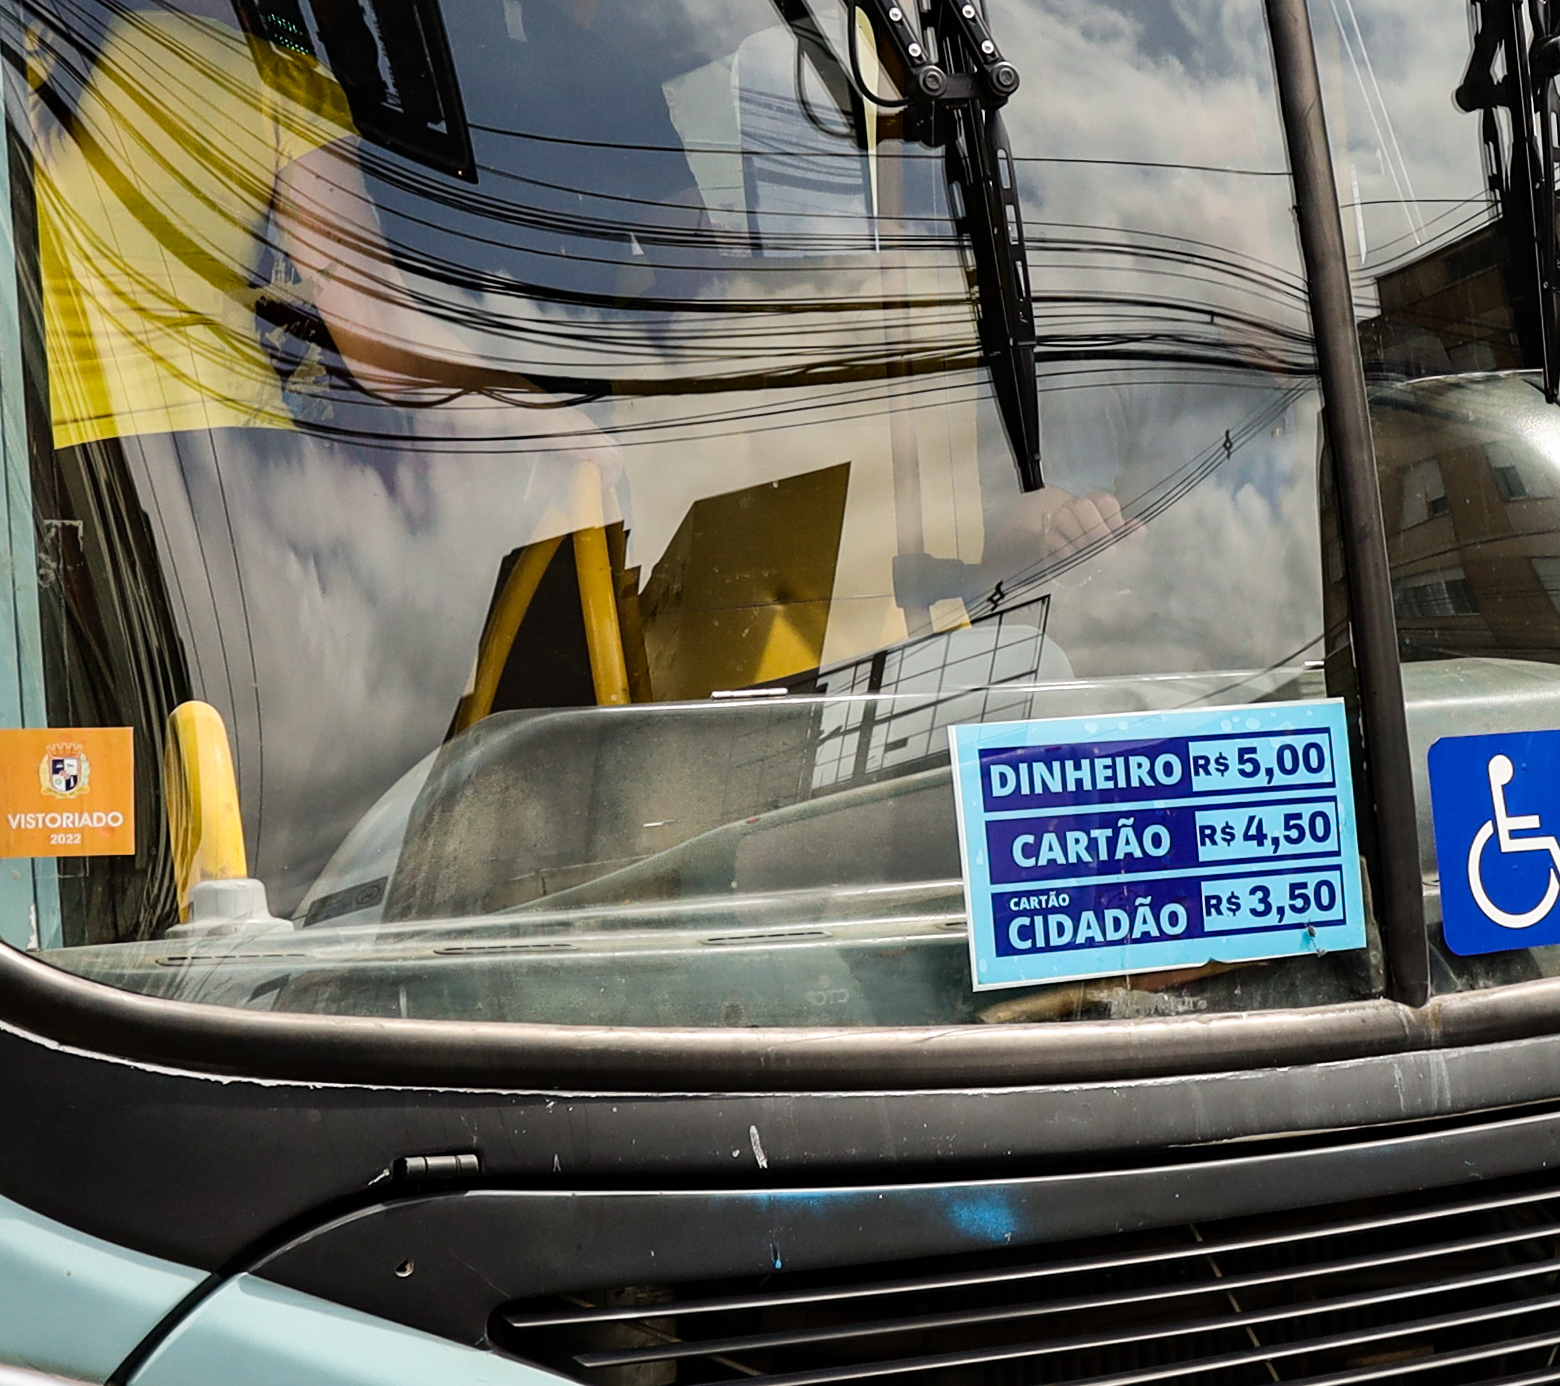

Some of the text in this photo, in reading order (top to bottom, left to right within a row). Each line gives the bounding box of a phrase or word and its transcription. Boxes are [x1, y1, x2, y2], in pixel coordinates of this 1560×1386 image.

[989, 742, 1326, 798] DINHEIRO R$ 5,00
[7, 811, 124, 830] VISTORIADO
[49, 833, 82, 845] 2022
[1012, 811, 1332, 868] CARTÃO R$ 4,50
[1008, 879, 1337, 950] CIDADÃO R$ 3,50
[1009, 891, 1070, 911] CARTÃO
